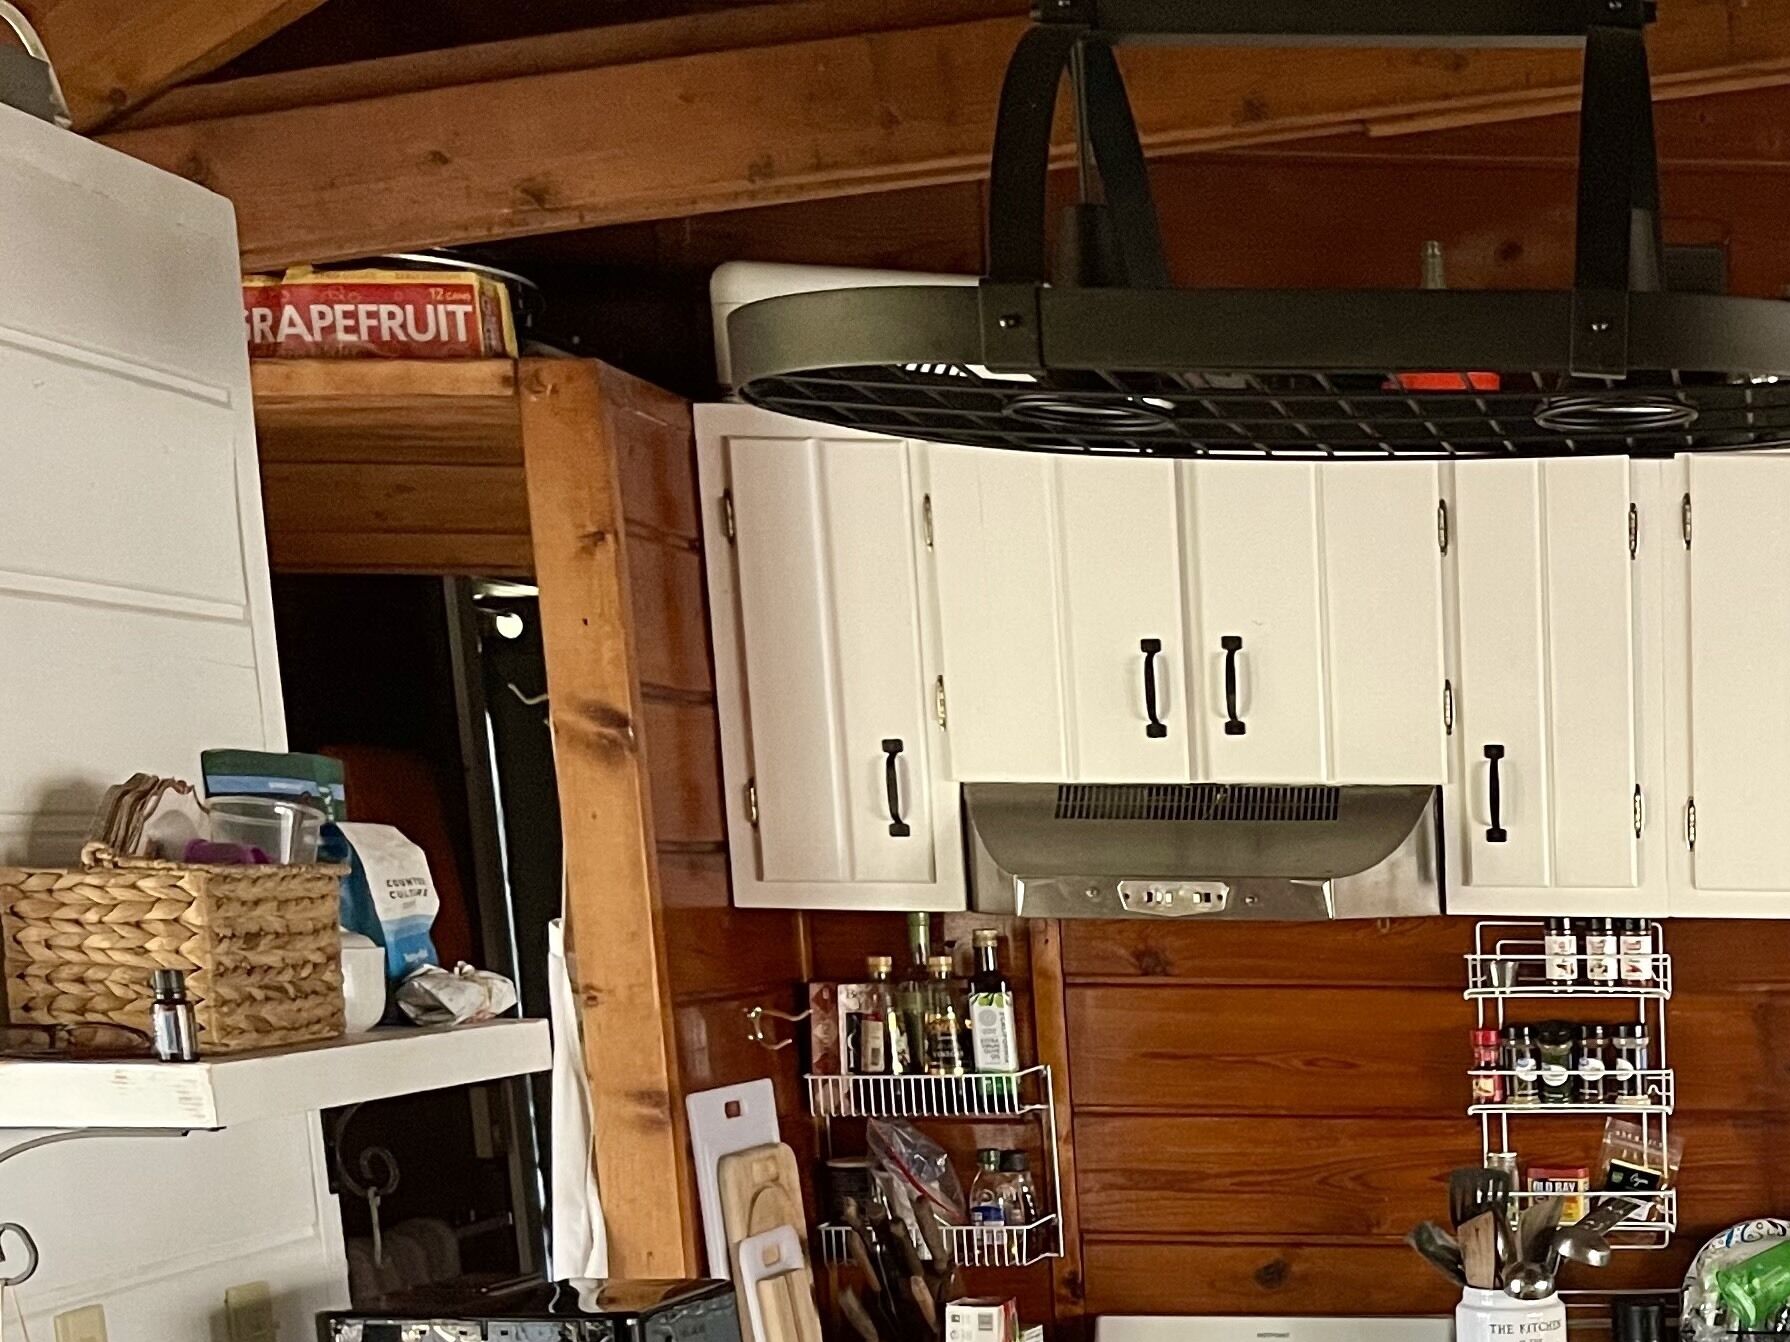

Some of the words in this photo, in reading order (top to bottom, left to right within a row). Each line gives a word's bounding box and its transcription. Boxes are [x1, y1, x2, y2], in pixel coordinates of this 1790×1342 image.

[245, 303, 474, 344] RAPEFRUIT
[1533, 1181, 1552, 1192] OLD
[1555, 1181, 1576, 1192] BAY
[1489, 1324, 1514, 1334] THE
